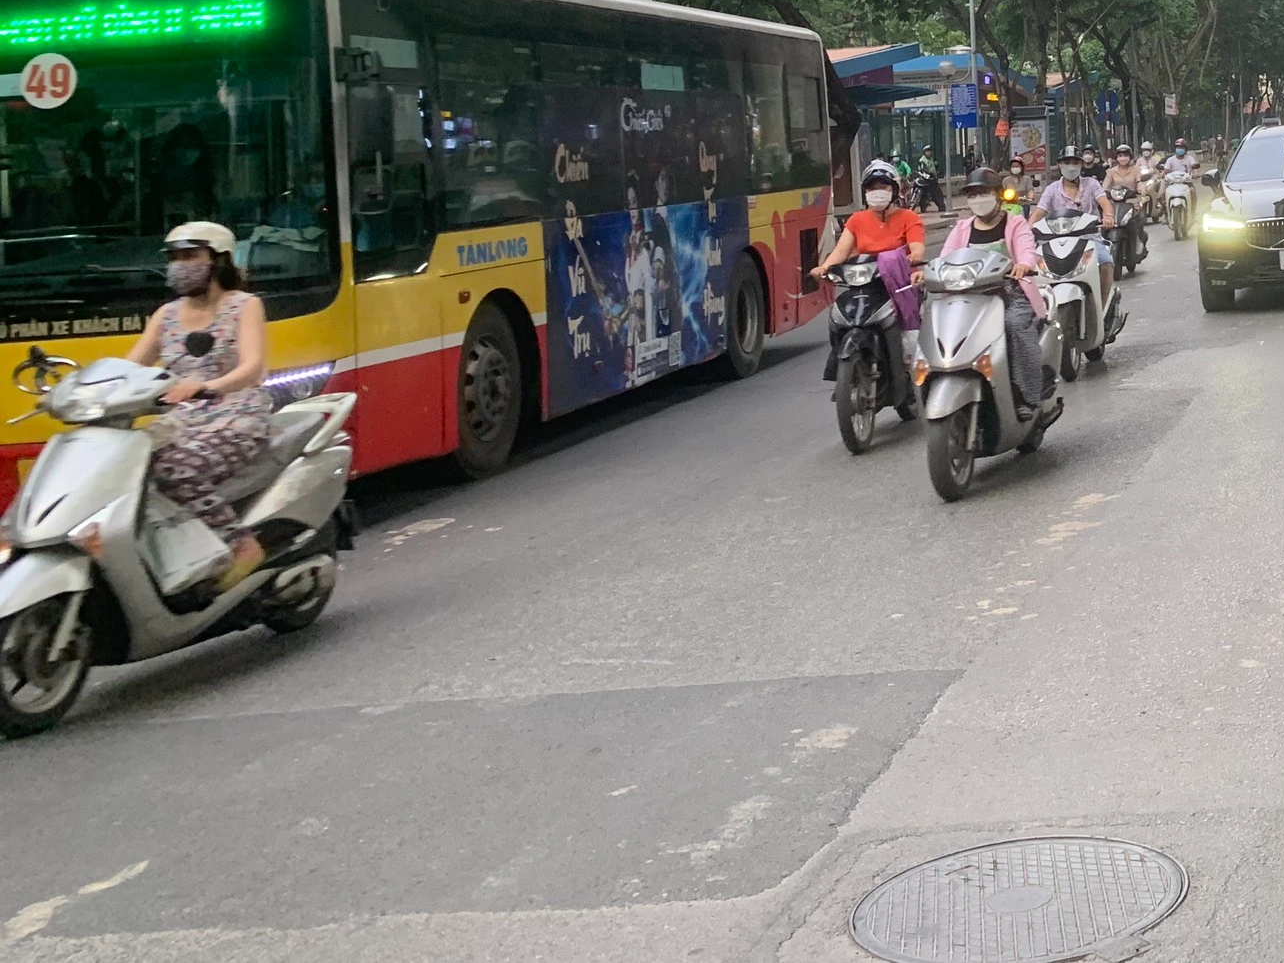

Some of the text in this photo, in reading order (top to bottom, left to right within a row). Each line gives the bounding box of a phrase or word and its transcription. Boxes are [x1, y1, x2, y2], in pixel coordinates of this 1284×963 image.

[25, 63, 71, 99] 49
[51, 320, 70, 336] XE
[72, 315, 120, 334] KHÁCH
